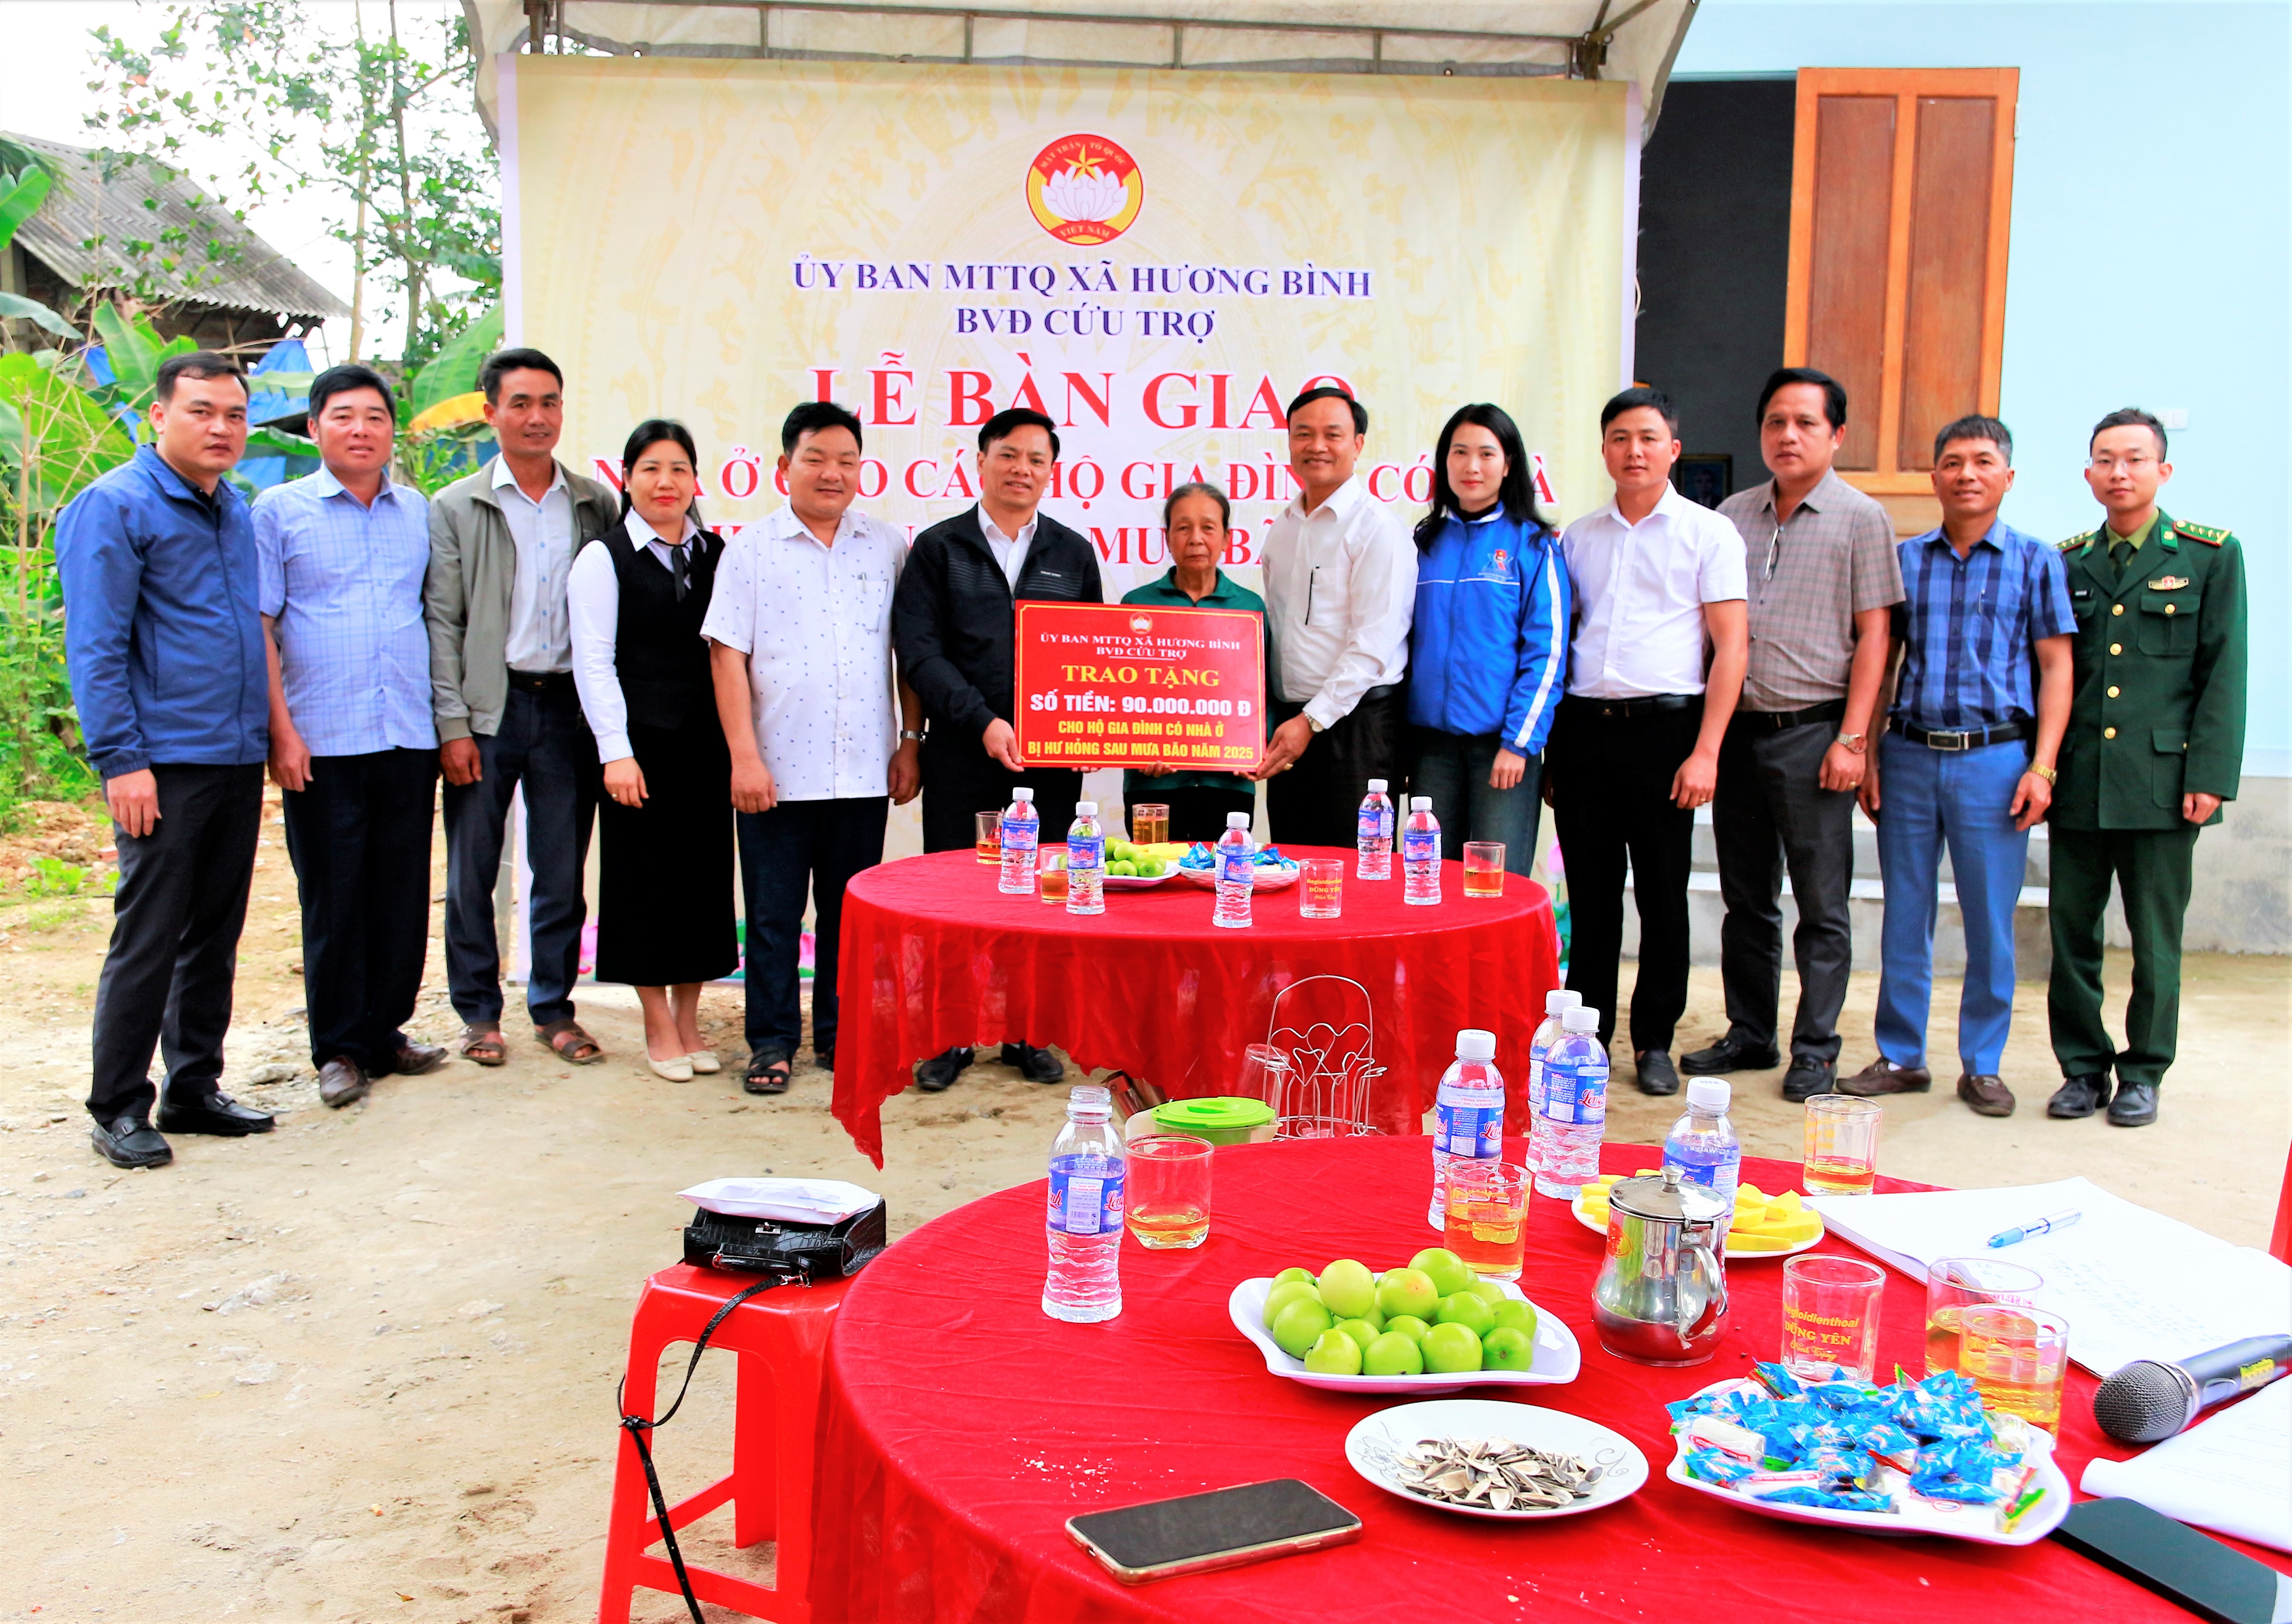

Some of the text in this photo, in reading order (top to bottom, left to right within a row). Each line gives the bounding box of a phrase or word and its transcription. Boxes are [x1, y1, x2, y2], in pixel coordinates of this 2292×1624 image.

[793, 254, 1372, 297] ỦY BAN MTTQ XÃ HƯƠNG BÌNH
[956, 302, 1216, 344] BVĐ CỨU TRỢ
[944, 352, 1117, 428] BÀN
[1142, 373, 1356, 430] GIA
[722, 447, 761, 498] Ở
[905, 449, 985, 498] CÁ
[1225, 451, 1306, 500] ĐÌN
[1368, 454, 1436, 502] CÓ
[1040, 632, 1240, 650] ỦY BAN MTTQ XÃ HƯƠNG BÌNH
[1096, 646, 1187, 660] BVĐ CỨU TRỢ
[1061, 664, 1220, 689] TRAO TẶNG
[1030, 688, 1251, 717] SỐ TIỀN: 90.000.000 Đ
[1058, 718, 1224, 738] CHO HỘ GIA ĐÌNH CÓ NHÀ Ở
[1027, 738, 1254, 760] BỊ HƯ HỎNG SAU MƯA BÃO NĂM 2025
[1784, 1302, 1859, 1328] hegioidienthoai
[1820, 1332, 1852, 1345] YÊN
